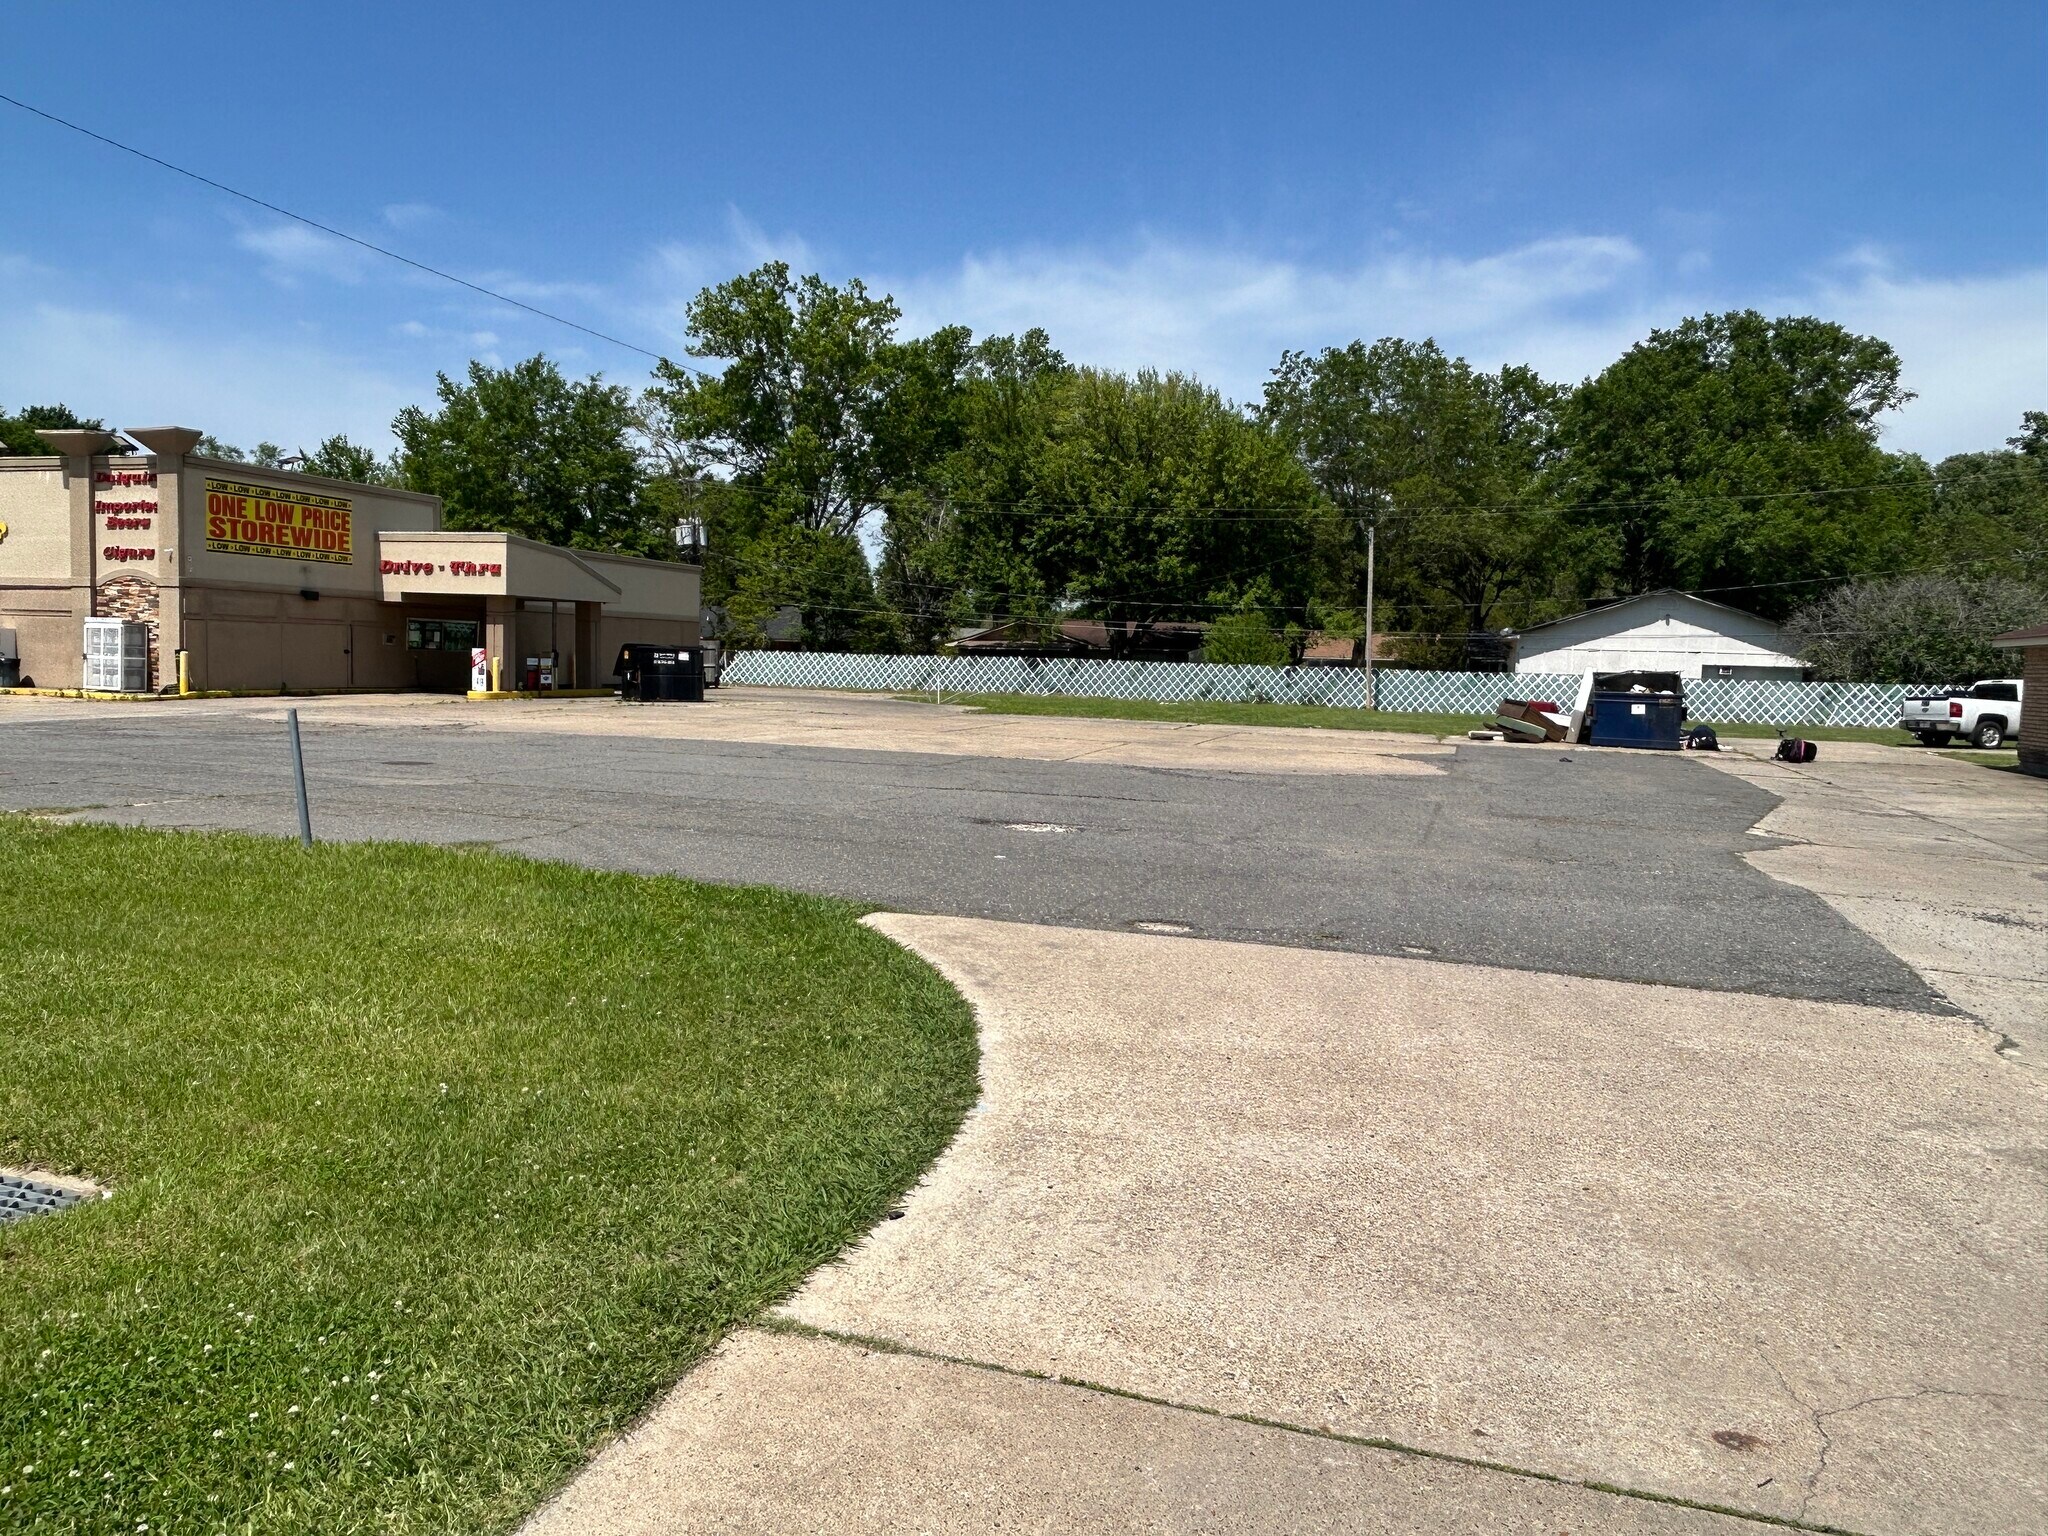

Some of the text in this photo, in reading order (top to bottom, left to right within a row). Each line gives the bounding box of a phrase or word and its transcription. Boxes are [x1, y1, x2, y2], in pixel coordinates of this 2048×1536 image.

[211, 482, 348, 508] LOW LOW LOW LOW LOW LOW LOW
[208, 493, 351, 532] ONE LOW PRICE
[208, 516, 350, 552] STOREWIDE
[212, 542, 349, 562] LOW LOW LOW LOW LOW LOW LOW
[379, 560, 434, 576] Drive
[450, 561, 502, 577] Thru
